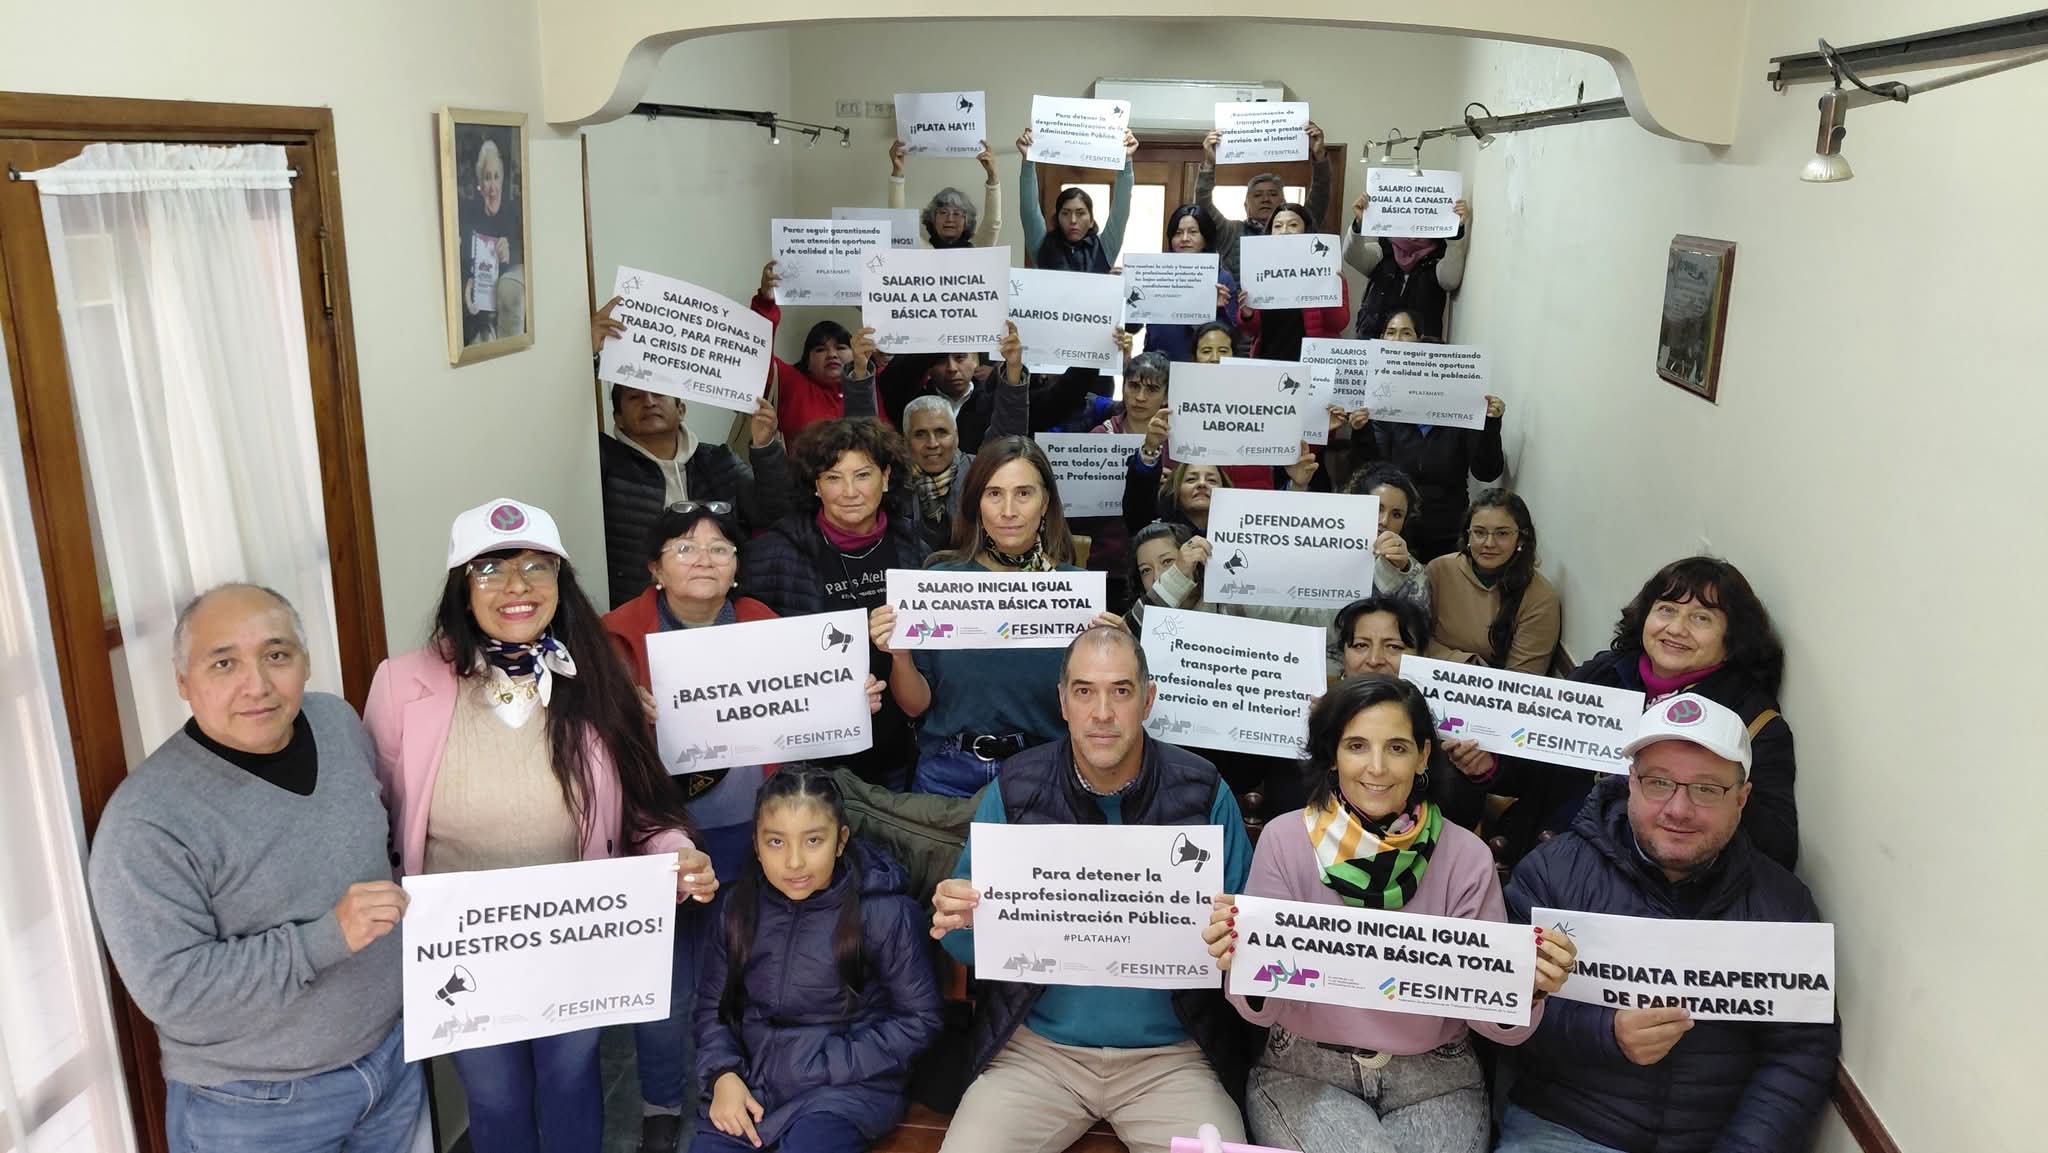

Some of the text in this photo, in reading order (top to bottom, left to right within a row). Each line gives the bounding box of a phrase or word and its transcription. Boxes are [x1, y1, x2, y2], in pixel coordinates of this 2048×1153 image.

[910, 122, 975, 134] ¡¡PLATA HAY!!
[1382, 205, 1411, 214] BÁSICA
[806, 227, 829, 235] seguir
[831, 228, 880, 236] garantizando
[780, 248, 784, 256] y
[882, 274, 986, 286] SALARIO INICIAL
[1257, 267, 1331, 282] ¡¡PLATA HAY!!
[662, 291, 730, 317] SALARIOS Y
[869, 290, 999, 303] IGUAL A LA CANASTA
[891, 307, 978, 319] BÁSICA TOTAL
[1062, 312, 1112, 325] DIGNOS!
[617, 298, 767, 348] CONDICIONES DIGNAS DE
[620, 313, 758, 357] TRABAJO, PARA FRENAR
[947, 334, 1001, 344] FESINTRAS
[633, 333, 741, 366] LA CRISIS DE RRHH
[1061, 349, 1110, 360] FESINTRAS
[1403, 350, 1427, 359] seguir
[642, 351, 722, 378] PROFESIONAL
[1302, 357, 1357, 365] CONDICIONES
[1402, 360, 1437, 368] atención
[1439, 362, 1475, 370] oportuna
[1392, 369, 1422, 377] calidad
[1440, 371, 1483, 380] población.
[692, 381, 752, 402] FESINTRAS
[1178, 402, 1297, 415] ¡BASTA VIOLENCIA
[1432, 412, 1473, 420] FESINTRAS
[1203, 421, 1265, 432] LABORAL!
[1048, 444, 1108, 453] Por salarios
[1245, 446, 1296, 455] FESINTRAS
[1072, 458, 1118, 470] todos/as
[1239, 514, 1345, 530] ¡DEFENDAMOS
[1214, 531, 1369, 550] NUESTROS SALARIOS!
[917, 581, 1073, 593] SALARIO INICIAL IGUAL
[1297, 587, 1361, 598] FESINTRAS
[899, 596, 1092, 611] A LA CANASTA BÁSICA TOTAL
[1011, 623, 1091, 635] FESINTRA
[1170, 639, 1299, 664] ¡Reconocimiento de
[1180, 657, 1282, 684] transporte para
[672, 667, 853, 710] ¡BASTA VIOLENCIA
[1236, 685, 1260, 697] que
[1432, 669, 1605, 709] SALARIO INICIAL IGUAL
[716, 697, 810, 723] LABORAL!
[1158, 692, 1302, 718] servicio en el Interior!
[1423, 686, 1623, 731] LA CANASTA BÁSICA TOTAL
[786, 726, 861, 746] FESINTRAS
[1239, 729, 1304, 746] FESINTRAS
[1526, 731, 1623, 760] FESINTRAS
[1032, 867, 1162, 882] Para detener la
[983, 886, 1212, 905] desprofesionalización de la
[458, 893, 628, 933] ¡DEFENDAMOS
[998, 908, 1196, 926] Administración Pública.
[1274, 912, 1490, 949] SALARIO INICIAL IGUAL
[416, 916, 663, 962] NUESTROS SALARIOS!
[1063, 934, 1131, 944] #PLATAHAY!
[1247, 931, 1515, 974] A LA CANASTA BÁSICA TOTAL
[1120, 963, 1209, 976] FESINTRAS
[1683, 969, 1830, 991] REAPERTURA
[1399, 980, 1519, 1008] FESINTRAS
[558, 992, 656, 1017] FESINTRAS
[1602, 988, 1775, 1017] DE PARITARIAS!
